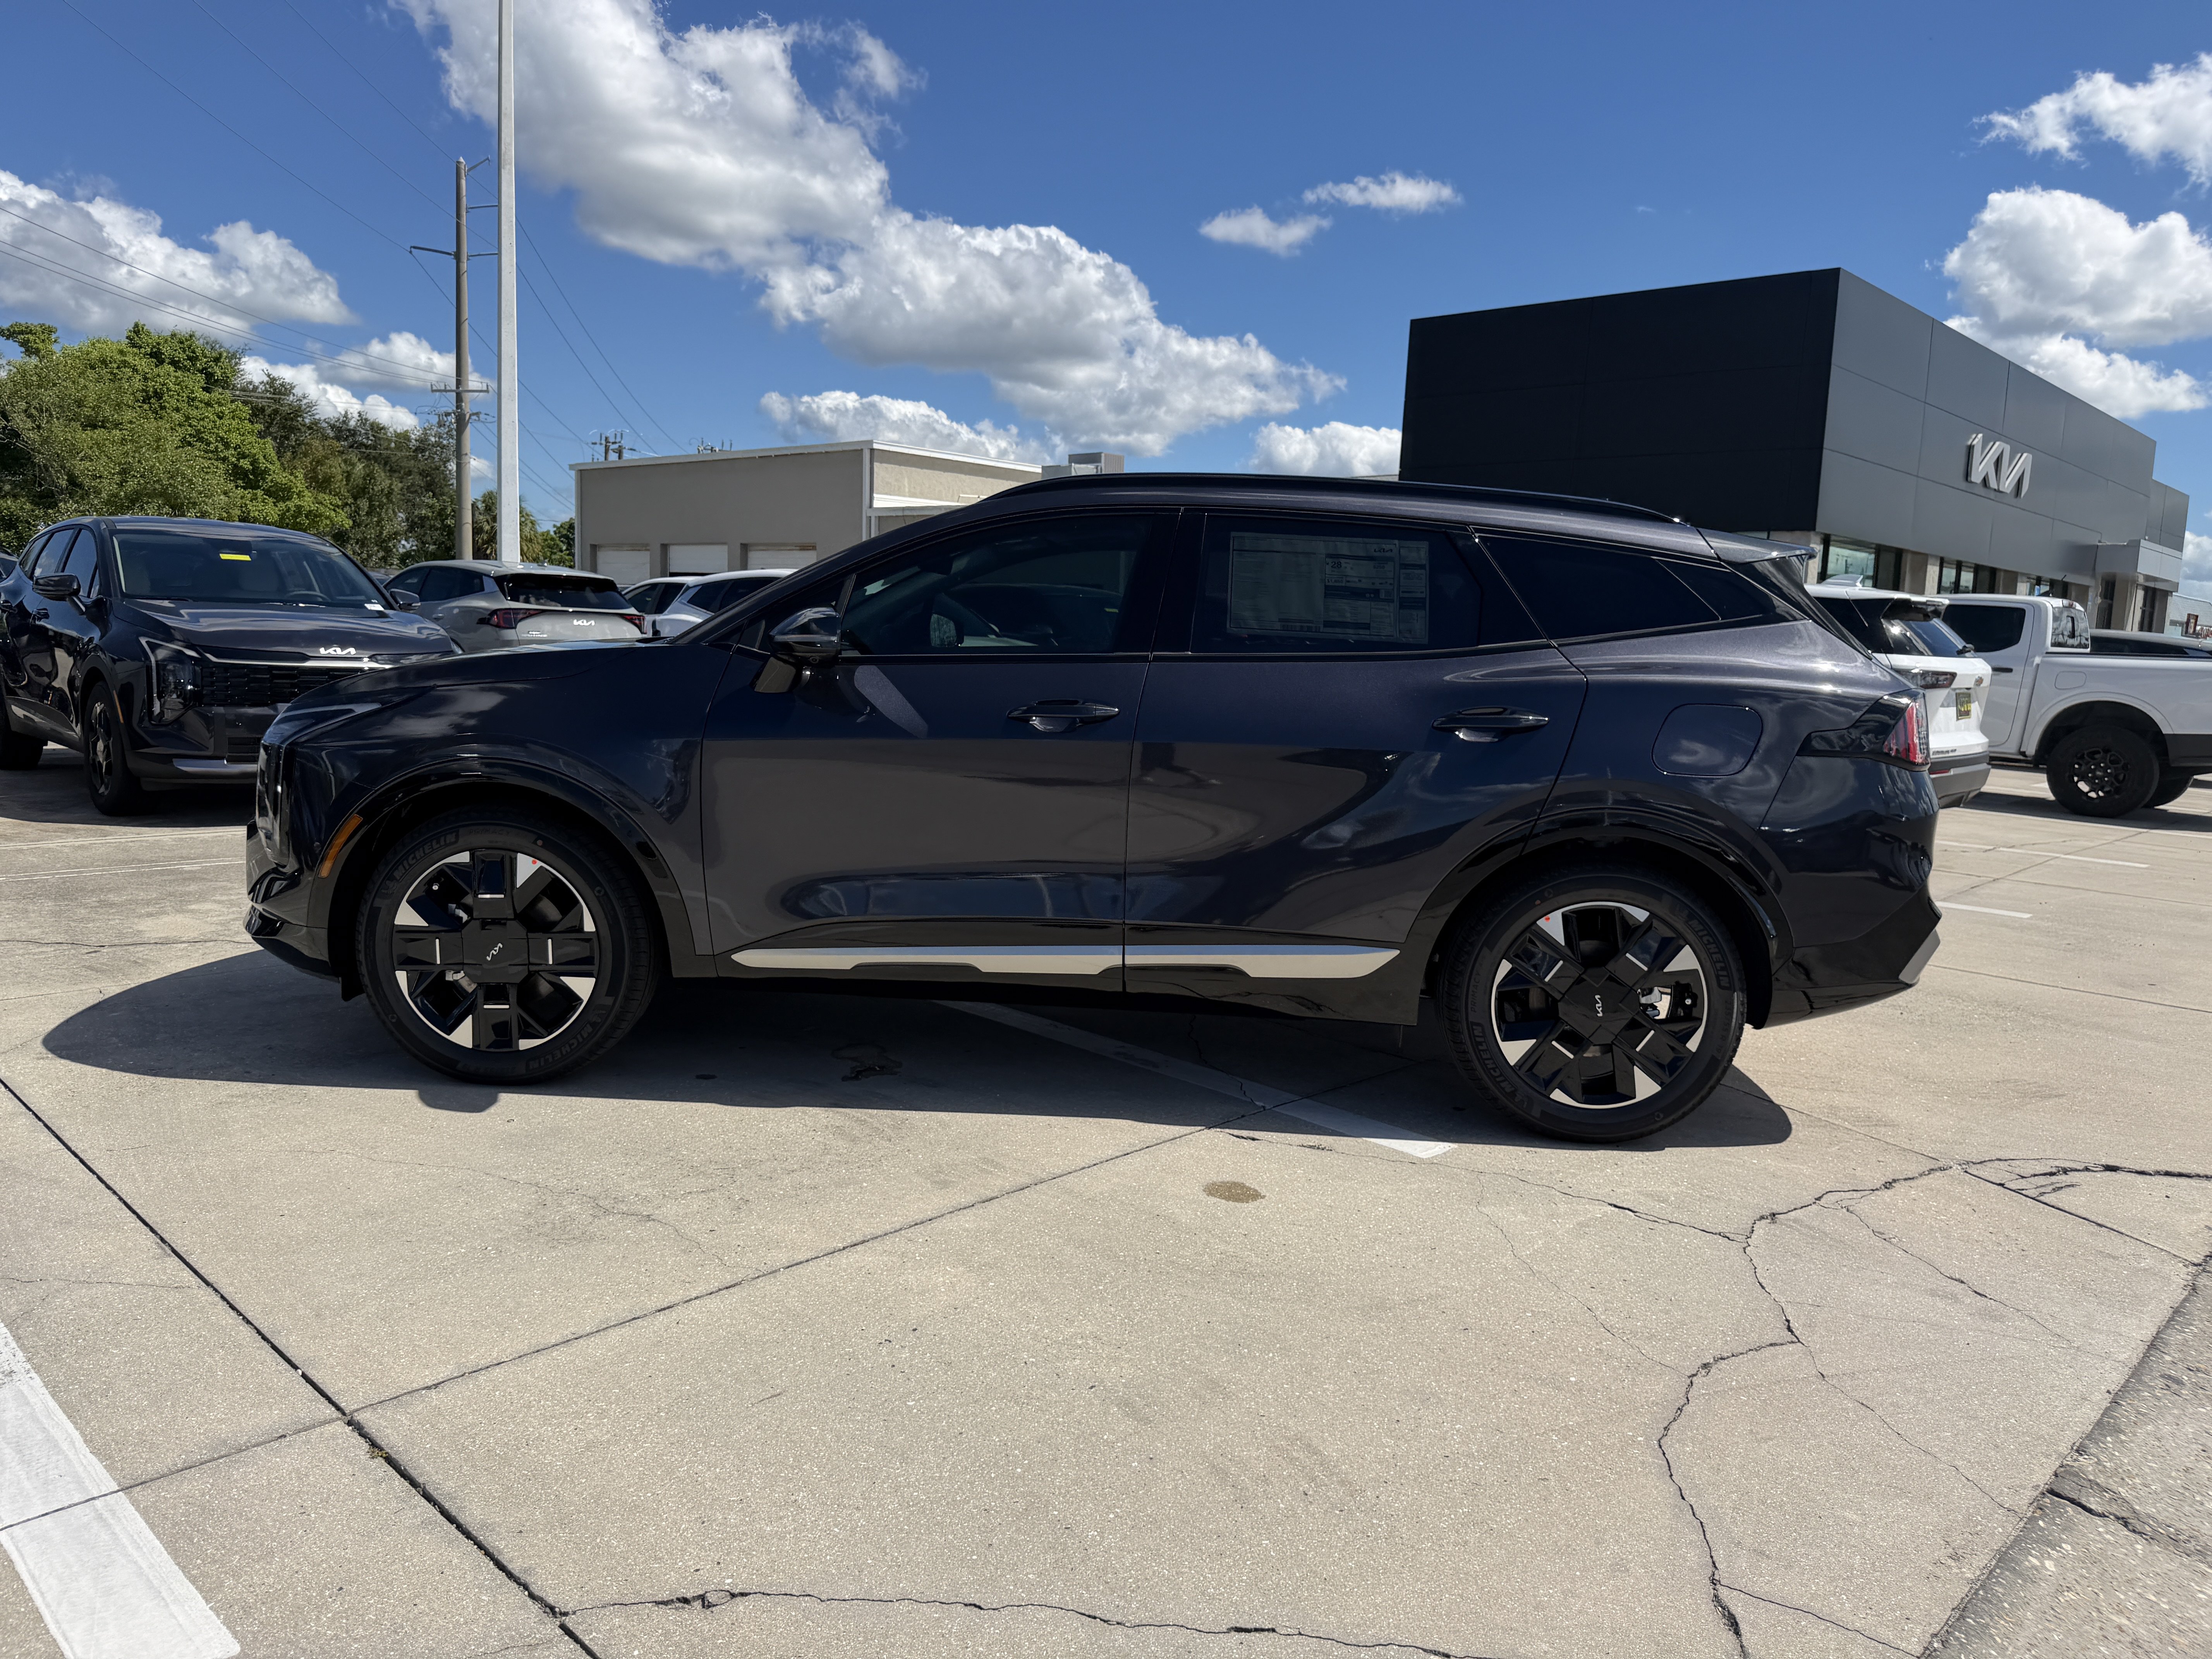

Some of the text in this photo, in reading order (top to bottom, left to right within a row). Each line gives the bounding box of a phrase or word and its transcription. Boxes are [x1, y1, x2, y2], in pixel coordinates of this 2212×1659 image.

[1966, 433, 2033, 499] KIA
[393, 833, 456, 880] MICHELIN
[486, 943, 503, 961] KIA
[1688, 919, 1729, 988] MICHELIN
[1595, 995, 1603, 1017] KIA
[529, 1023, 593, 1069] MICHELIN
[1470, 970, 1515, 1093] MICHELIN PRIMACY
